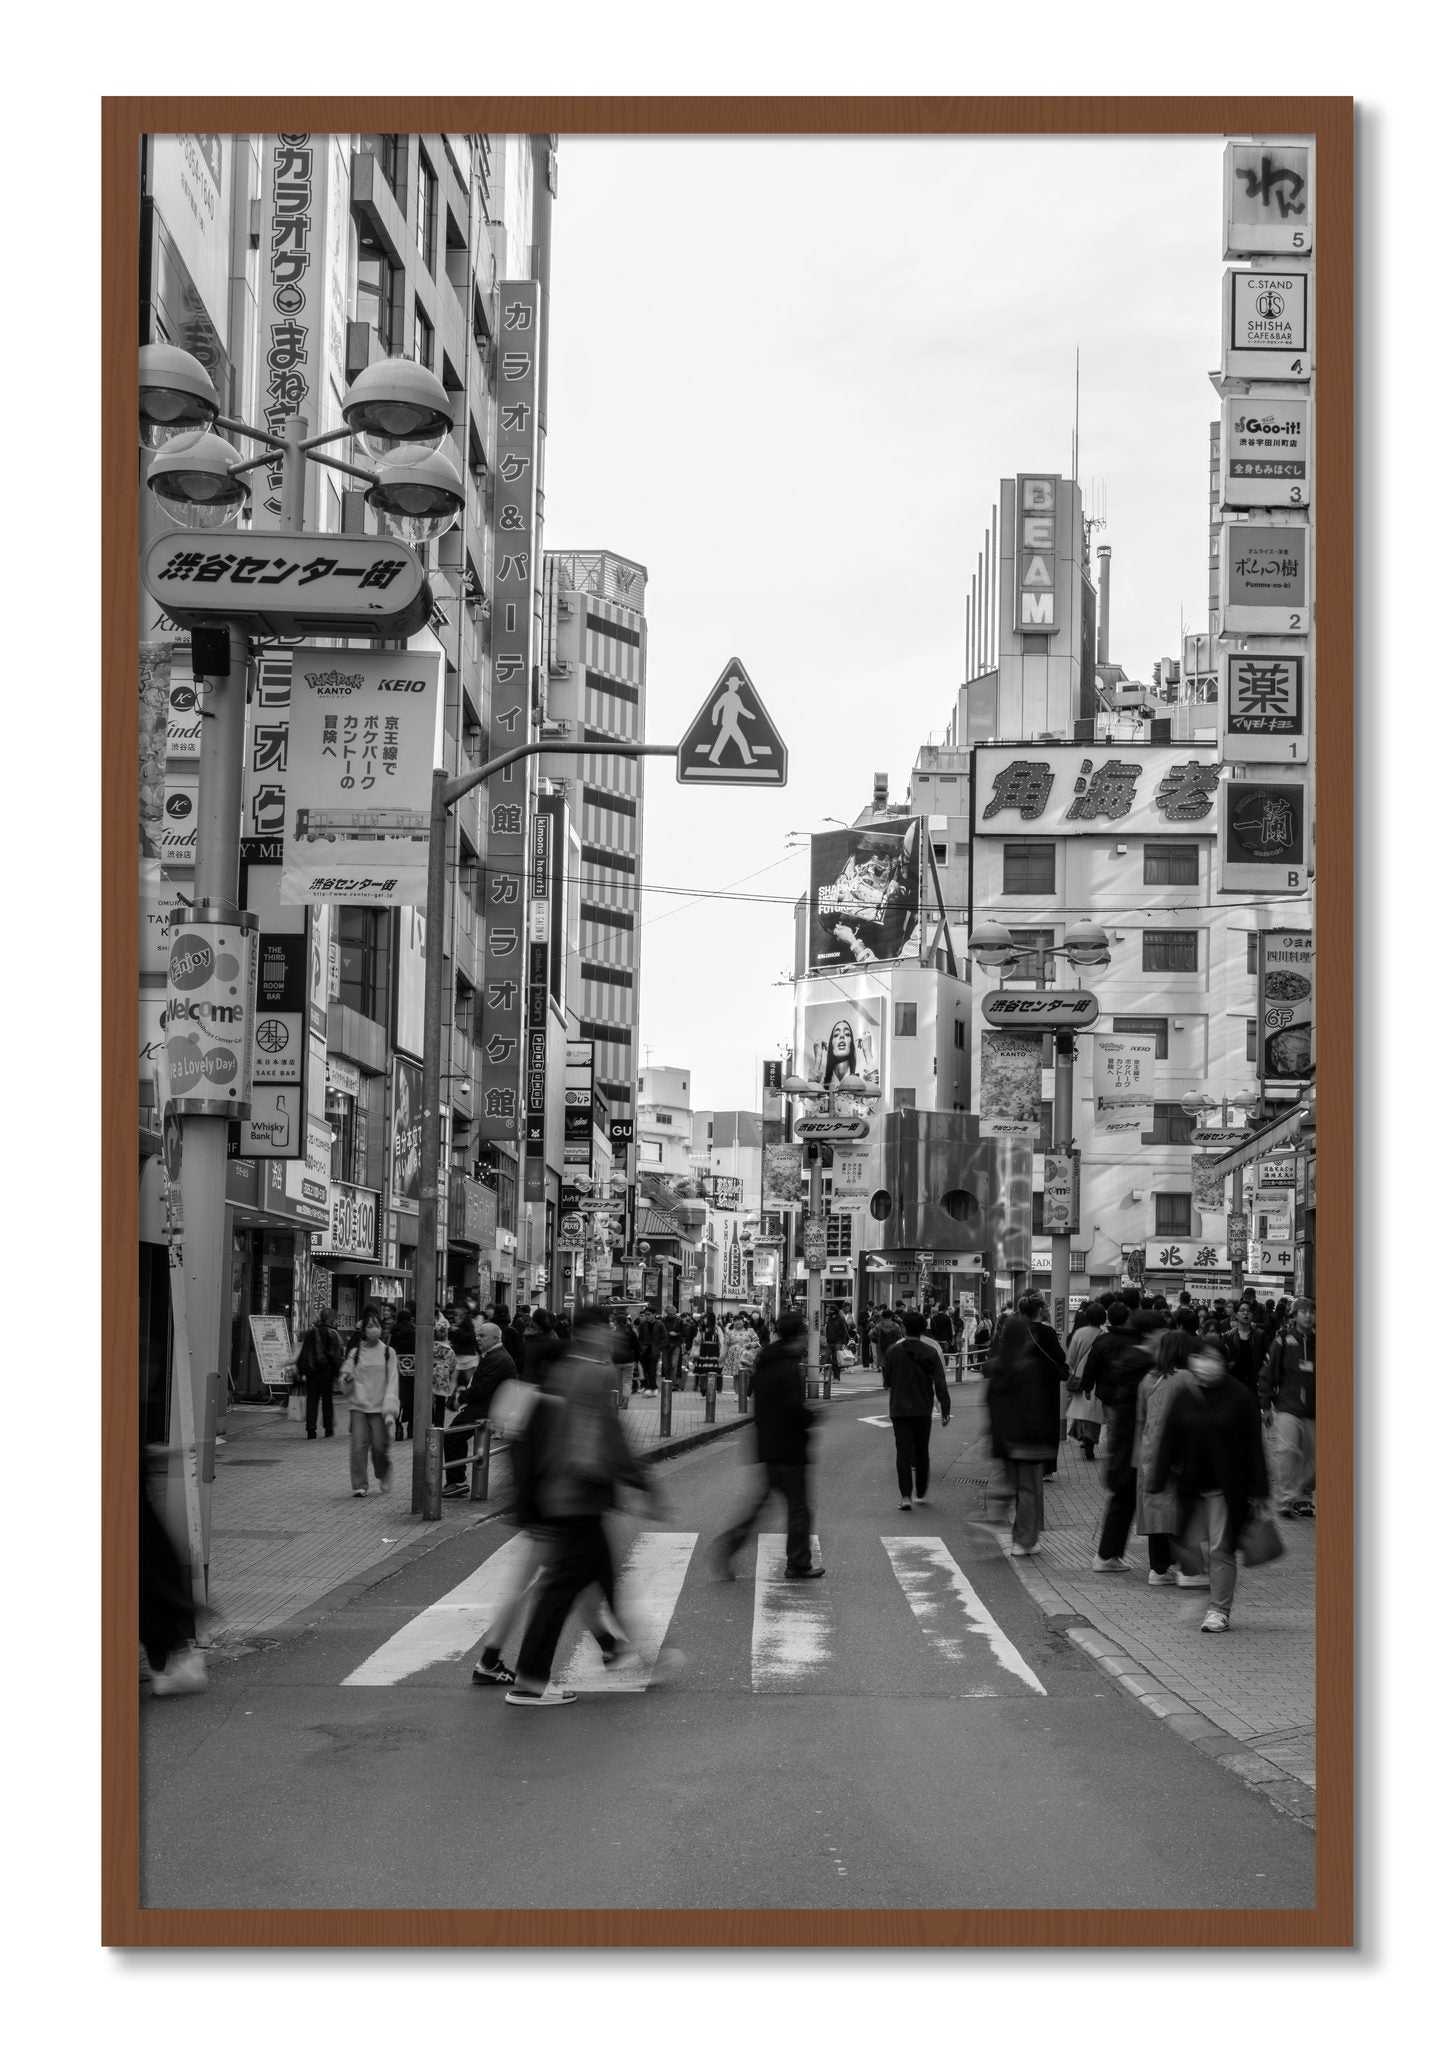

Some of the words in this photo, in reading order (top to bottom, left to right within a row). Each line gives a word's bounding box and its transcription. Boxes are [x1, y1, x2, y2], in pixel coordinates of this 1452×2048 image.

[271, 147, 313, 285] カラオケ
[1292, 232, 1304, 248] 5
[1247, 280, 1293, 289] C.STAND
[1247, 321, 1292, 331] SHISHA
[1247, 332, 1292, 340] CAFE&BAR
[1290, 359, 1303, 375] 4
[1246, 418, 1301, 434] Goo-it!
[1239, 438, 1297, 447] 渋谷宇田川町店
[1234, 463, 1302, 475] 全身もみほぐし
[1290, 486, 1302, 502] 3
[1022, 478, 1055, 625] BEAM
[157, 551, 408, 590] 渋谷センター街
[1289, 613, 1302, 630] 2
[317, 687, 352, 695] KANTO
[377, 679, 427, 693] KEIO
[1238, 662, 1289, 714] 薬
[1232, 716, 1295, 731] マツモトキヨシ
[321, 714, 338, 758] 冒険へ
[171, 742, 196, 751] 渋谷店
[340, 715, 358, 790] カントーの
[360, 715, 379, 790] ポケパーク
[382, 716, 400, 776] 京王線で
[1288, 742, 1297, 758] 1
[982, 759, 1222, 821] 角海老
[1233, 799, 1293, 847] 一蘭
[537, 819, 546, 854] kimono
[167, 850, 192, 859] 渋谷店
[308, 878, 398, 891] 渋谷センター街
[1287, 871, 1299, 887] B
[1266, 950, 1310, 962] 四川料理
[170, 948, 211, 983] Enjoy
[167, 998, 243, 1023] Welcome
[989, 999, 1093, 1013] 渋谷センター街
[1265, 1008, 1294, 1028] 6F
[183, 1056, 214, 1077] Lovely
[216, 1057, 236, 1071] Day!
[251, 1122, 285, 1133] Whisky
[612, 1126, 632, 1136] GU
[250, 1132, 271, 1140] Bank
[1159, 1245, 1219, 1266] 兆楽
[731, 1243, 740, 1286] BEER
